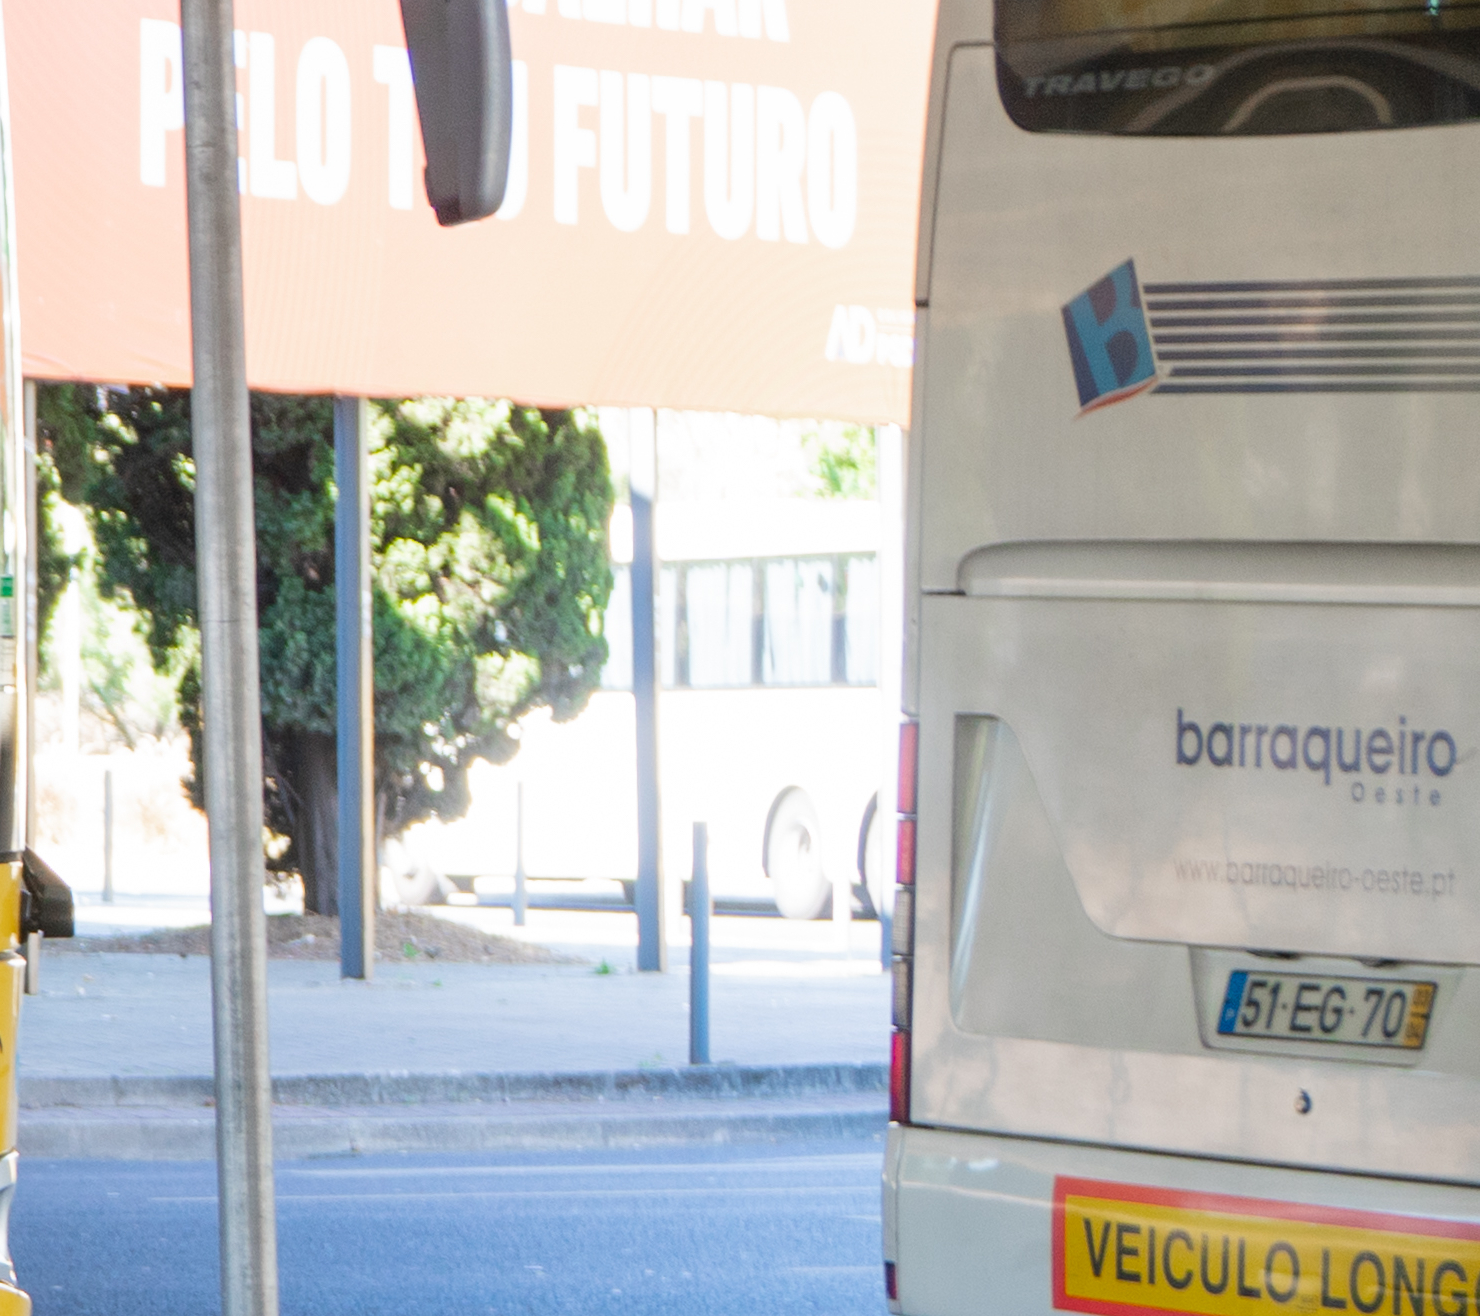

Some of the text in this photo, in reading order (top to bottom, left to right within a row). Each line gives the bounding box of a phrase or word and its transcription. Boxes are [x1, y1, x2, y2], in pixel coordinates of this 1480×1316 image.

[1022, 63, 1217, 98] TRAVEGO
[139, 17, 352, 208] PLO
[553, 63, 858, 250] FUTURO
[1176, 706, 1458, 786] barraqueiro
[1083, 1216, 1302, 1304] VEICULO
